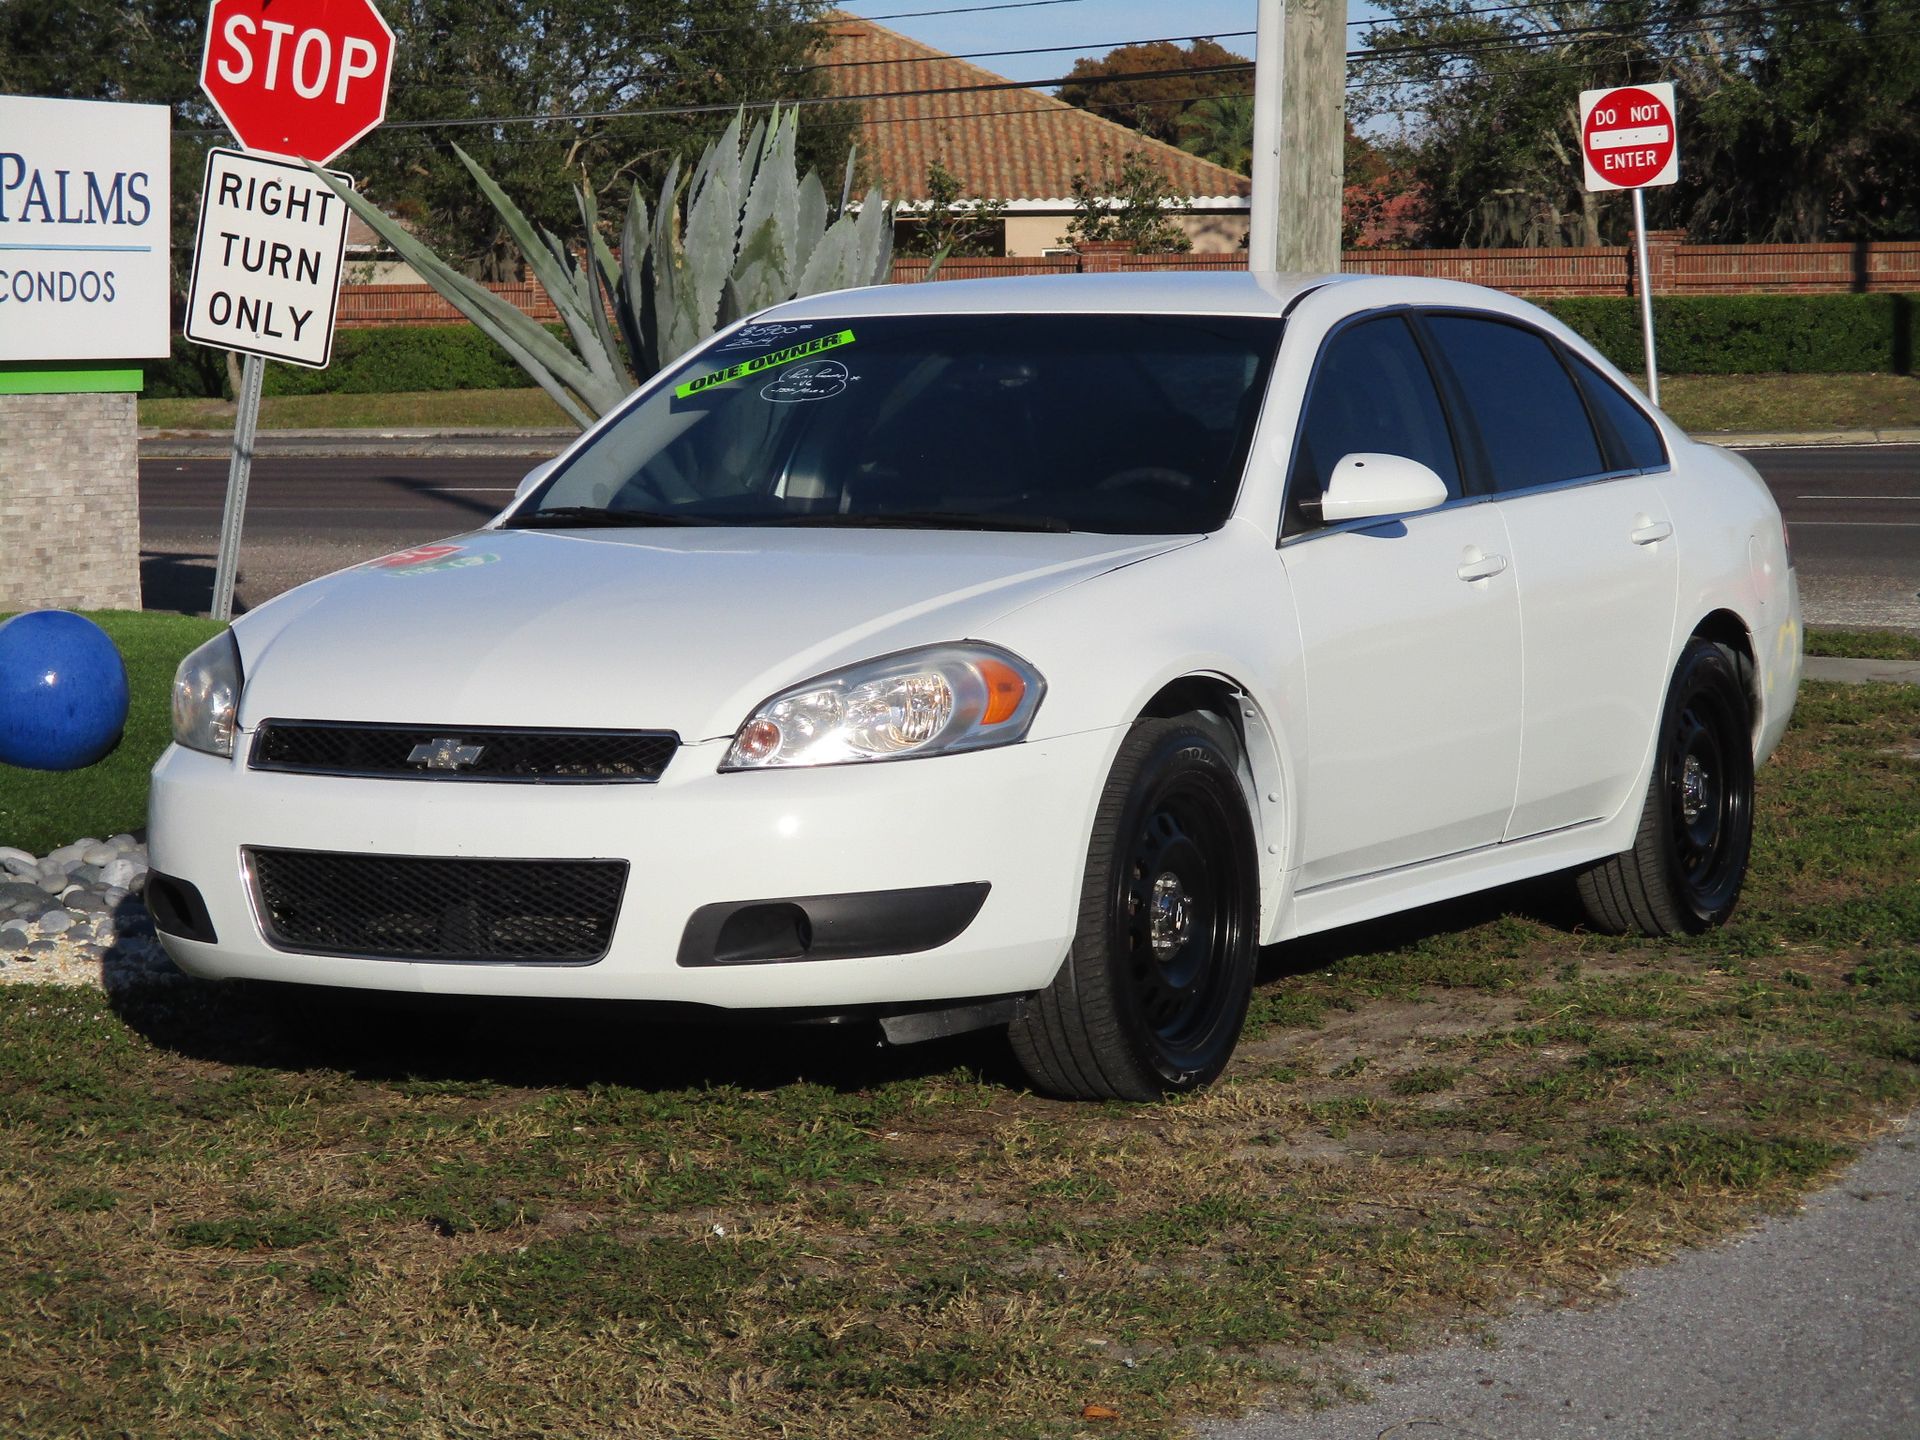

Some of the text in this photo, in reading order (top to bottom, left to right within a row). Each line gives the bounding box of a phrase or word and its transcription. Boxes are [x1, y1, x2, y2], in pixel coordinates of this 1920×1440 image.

[217, 14, 378, 105] STOP
[1595, 104, 1660, 126] DO NOT
[1603, 150, 1657, 170] ENTER
[0, 152, 151, 226] PALMS
[219, 172, 336, 226] RIGHT
[220, 232, 322, 285] TURN
[208, 291, 313, 342] ONLY
[689, 334, 842, 391] ONE OWNER
